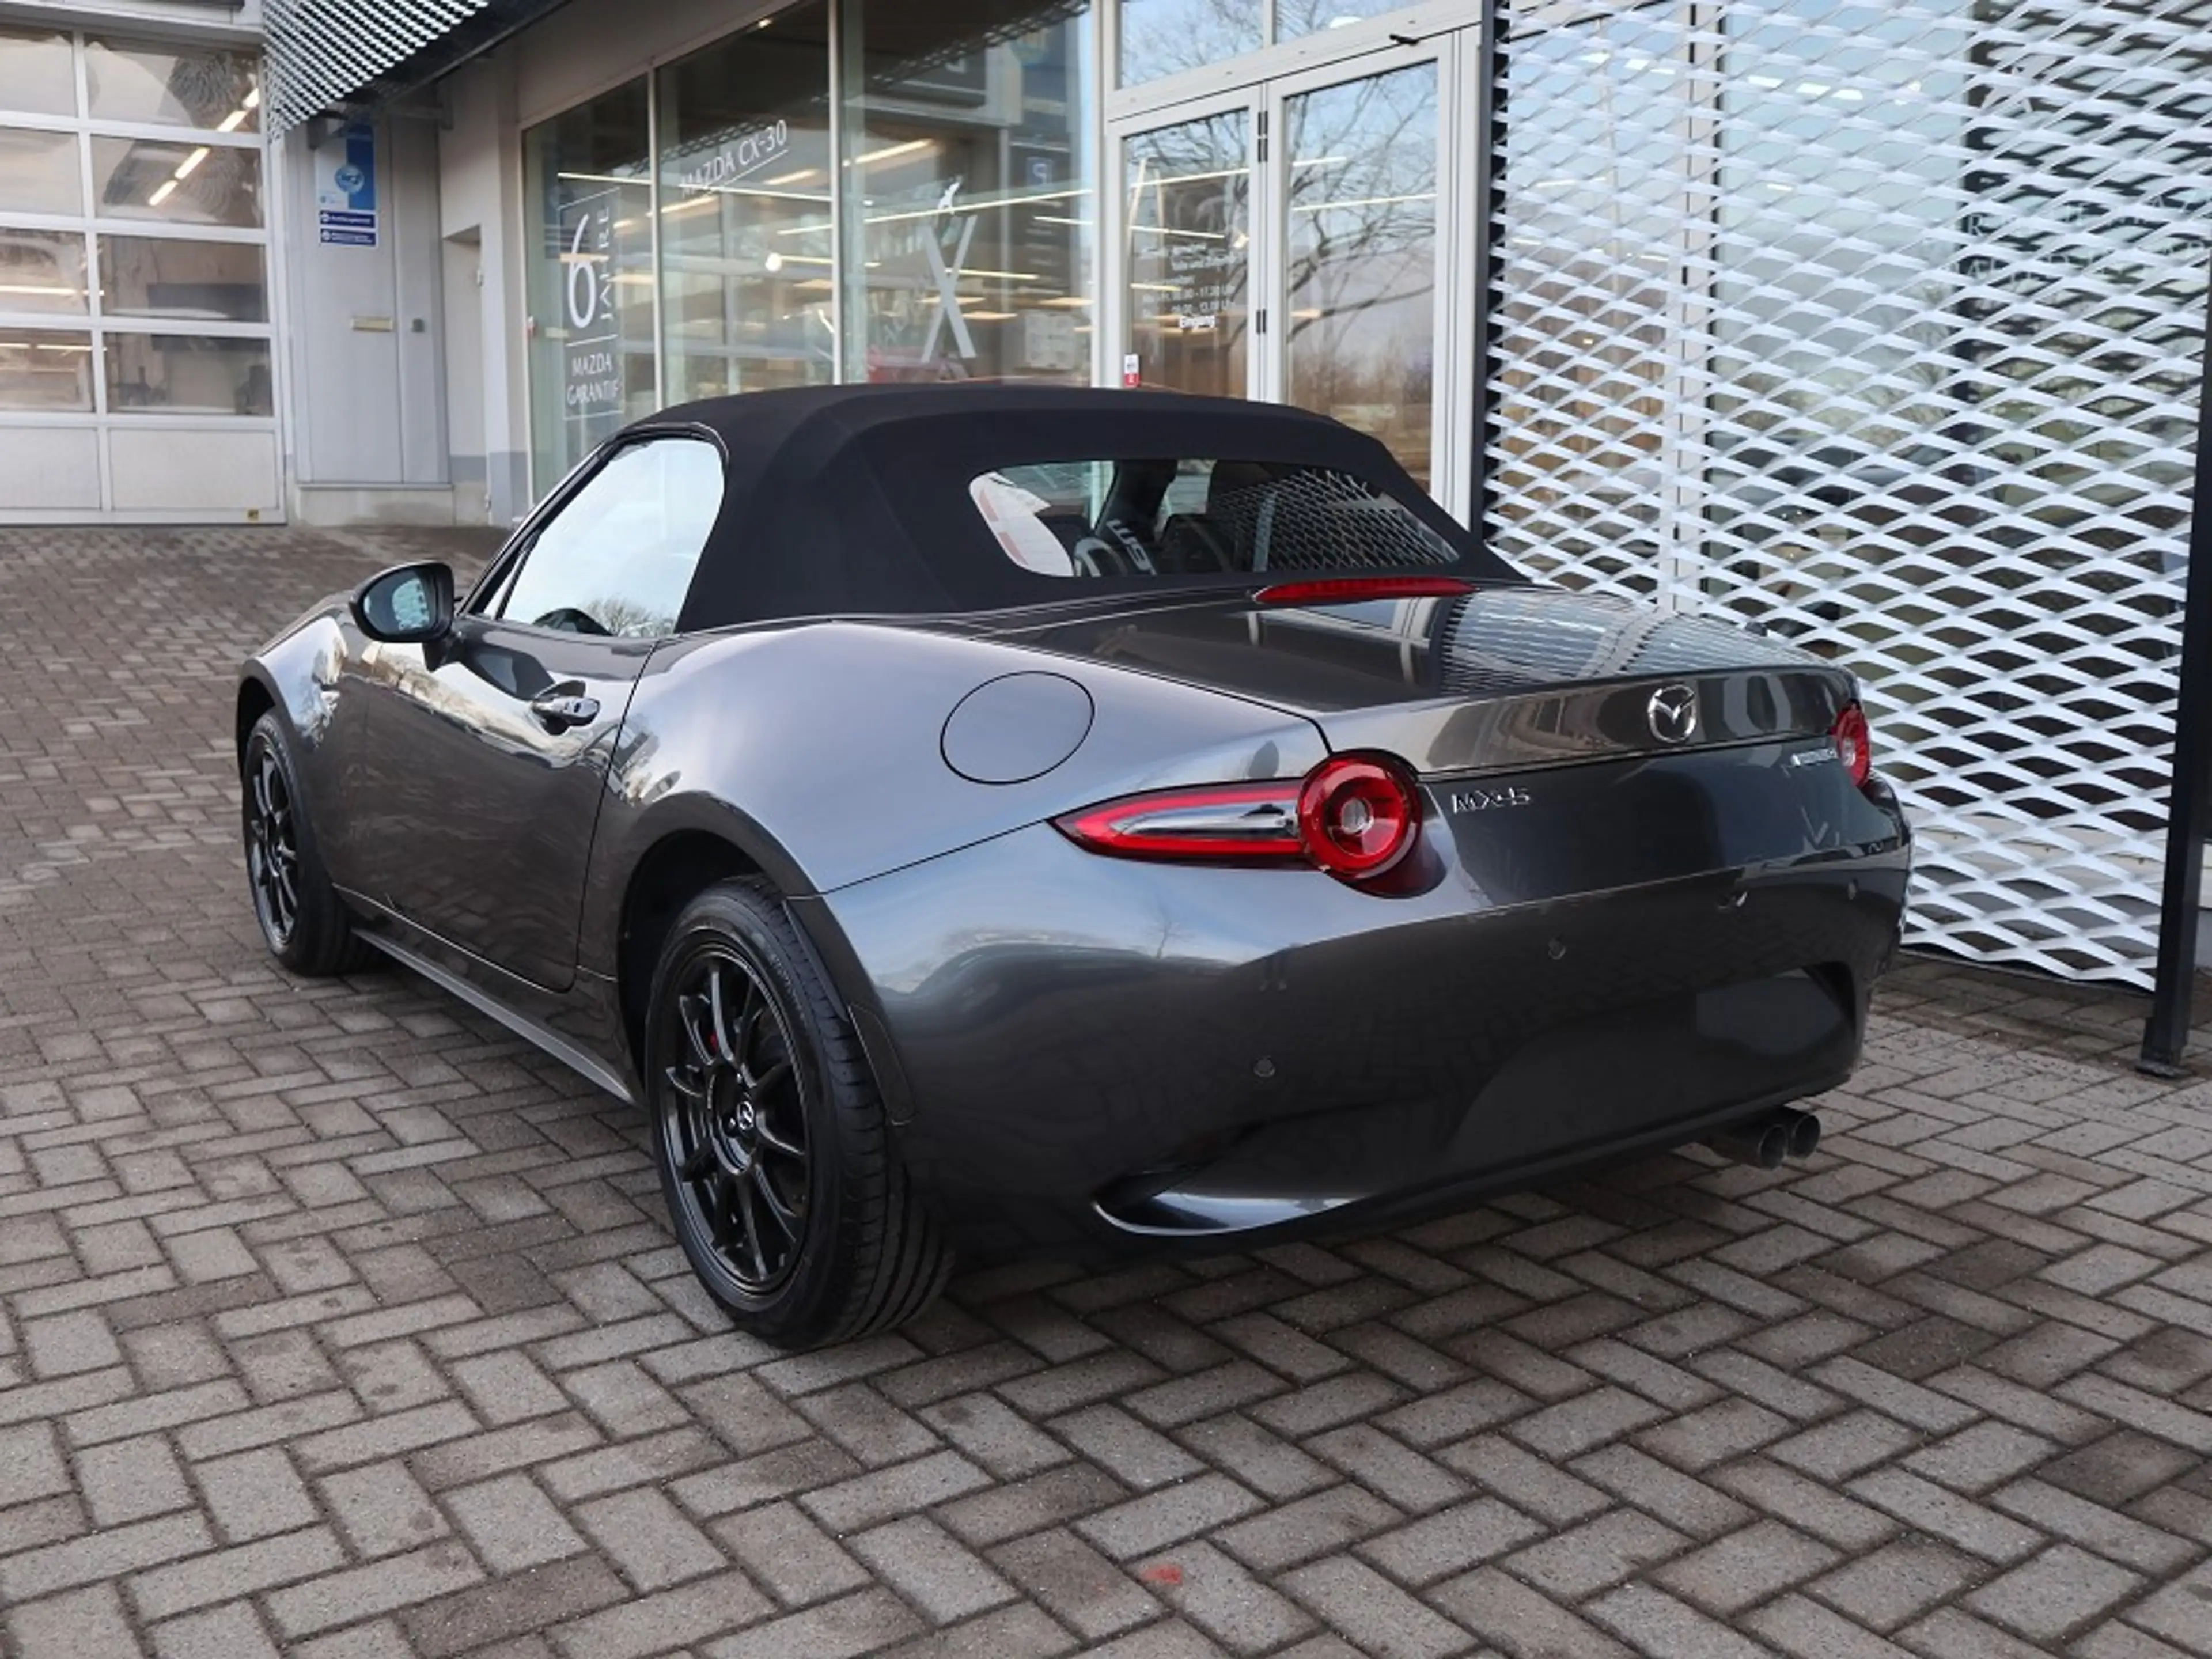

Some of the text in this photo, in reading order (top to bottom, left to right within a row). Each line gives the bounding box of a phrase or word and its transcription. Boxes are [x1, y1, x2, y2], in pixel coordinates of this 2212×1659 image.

[680, 119, 787, 198] MAZDA CX-30
[567, 213, 597, 328] 6
[571, 351, 613, 376] MAZDA
[1450, 786, 1531, 815] MX-5
